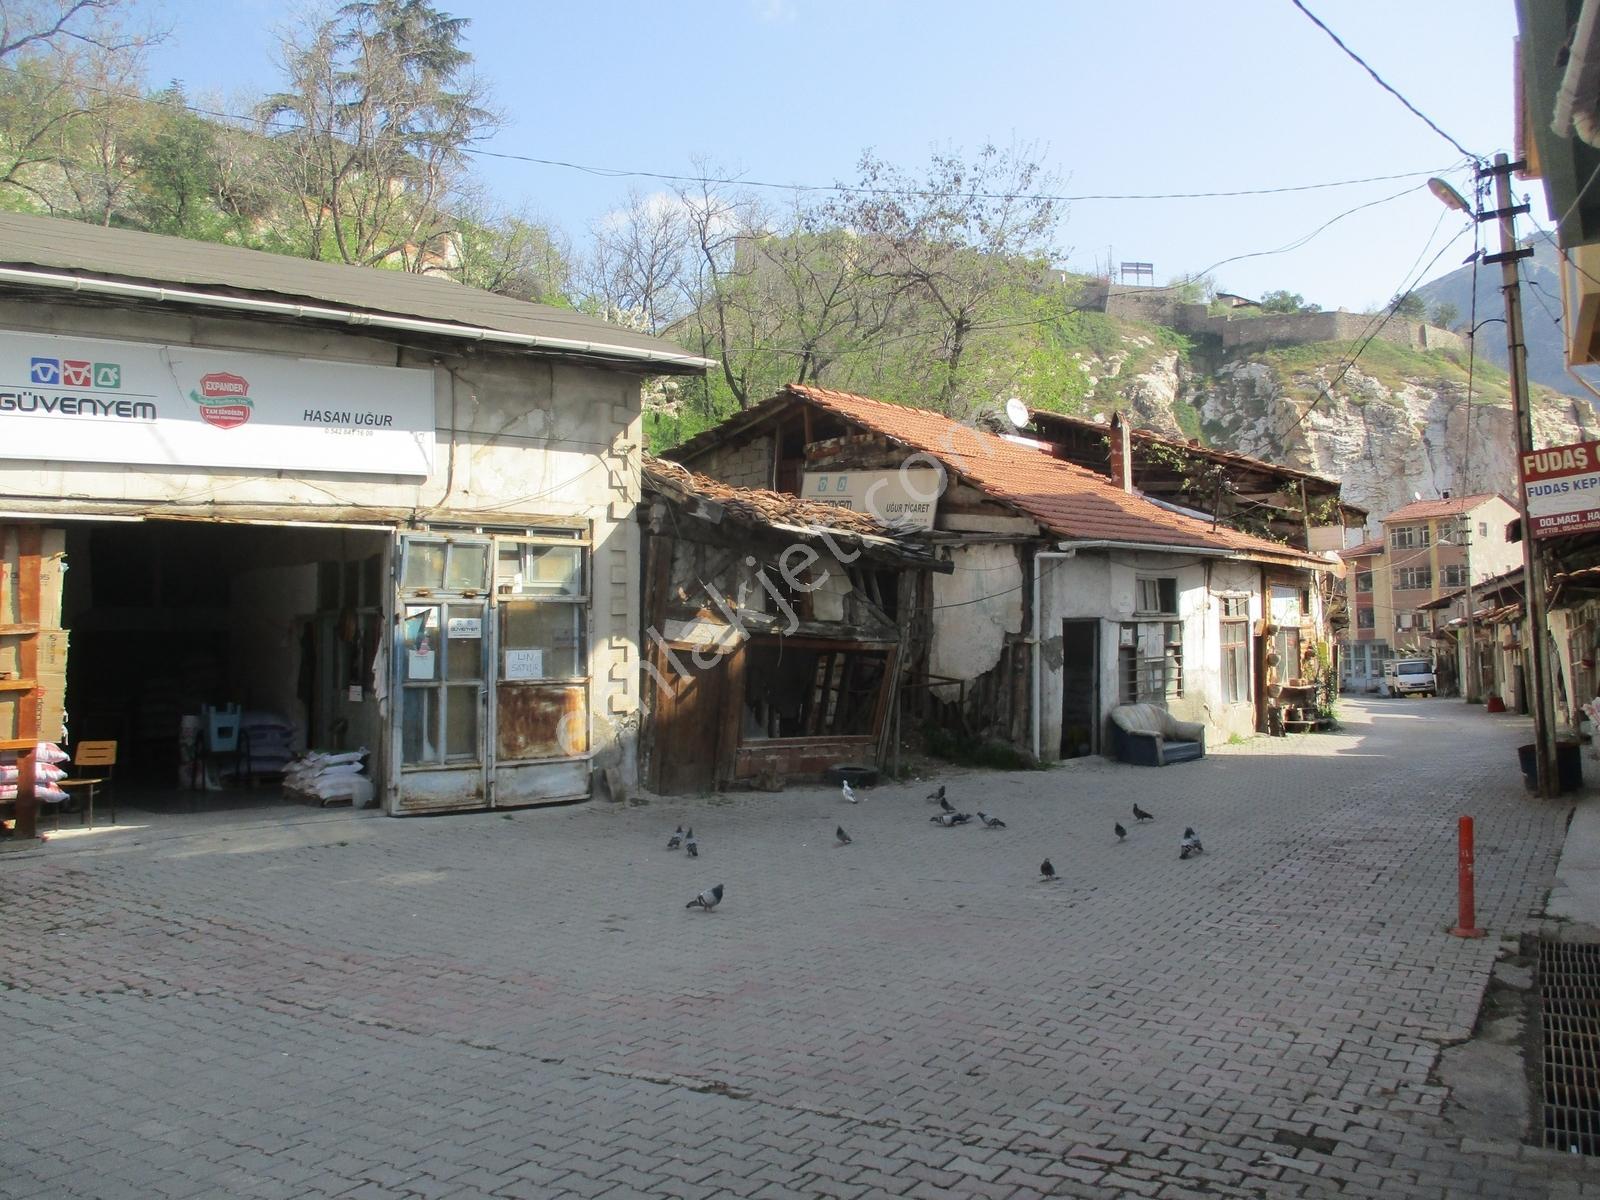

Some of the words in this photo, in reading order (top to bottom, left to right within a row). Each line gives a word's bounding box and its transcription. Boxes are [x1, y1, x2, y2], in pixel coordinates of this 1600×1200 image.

[205, 381, 243, 393] EXPANDER
[304, 409, 351, 424] HASAN
[354, 411, 393, 427] UĞUR
[1523, 448, 1588, 475] FUDAŞ
[1527, 482, 1570, 498] FUDAS
[903, 502, 930, 513] TİCARET
[1539, 514, 1580, 527] DOLMACI
